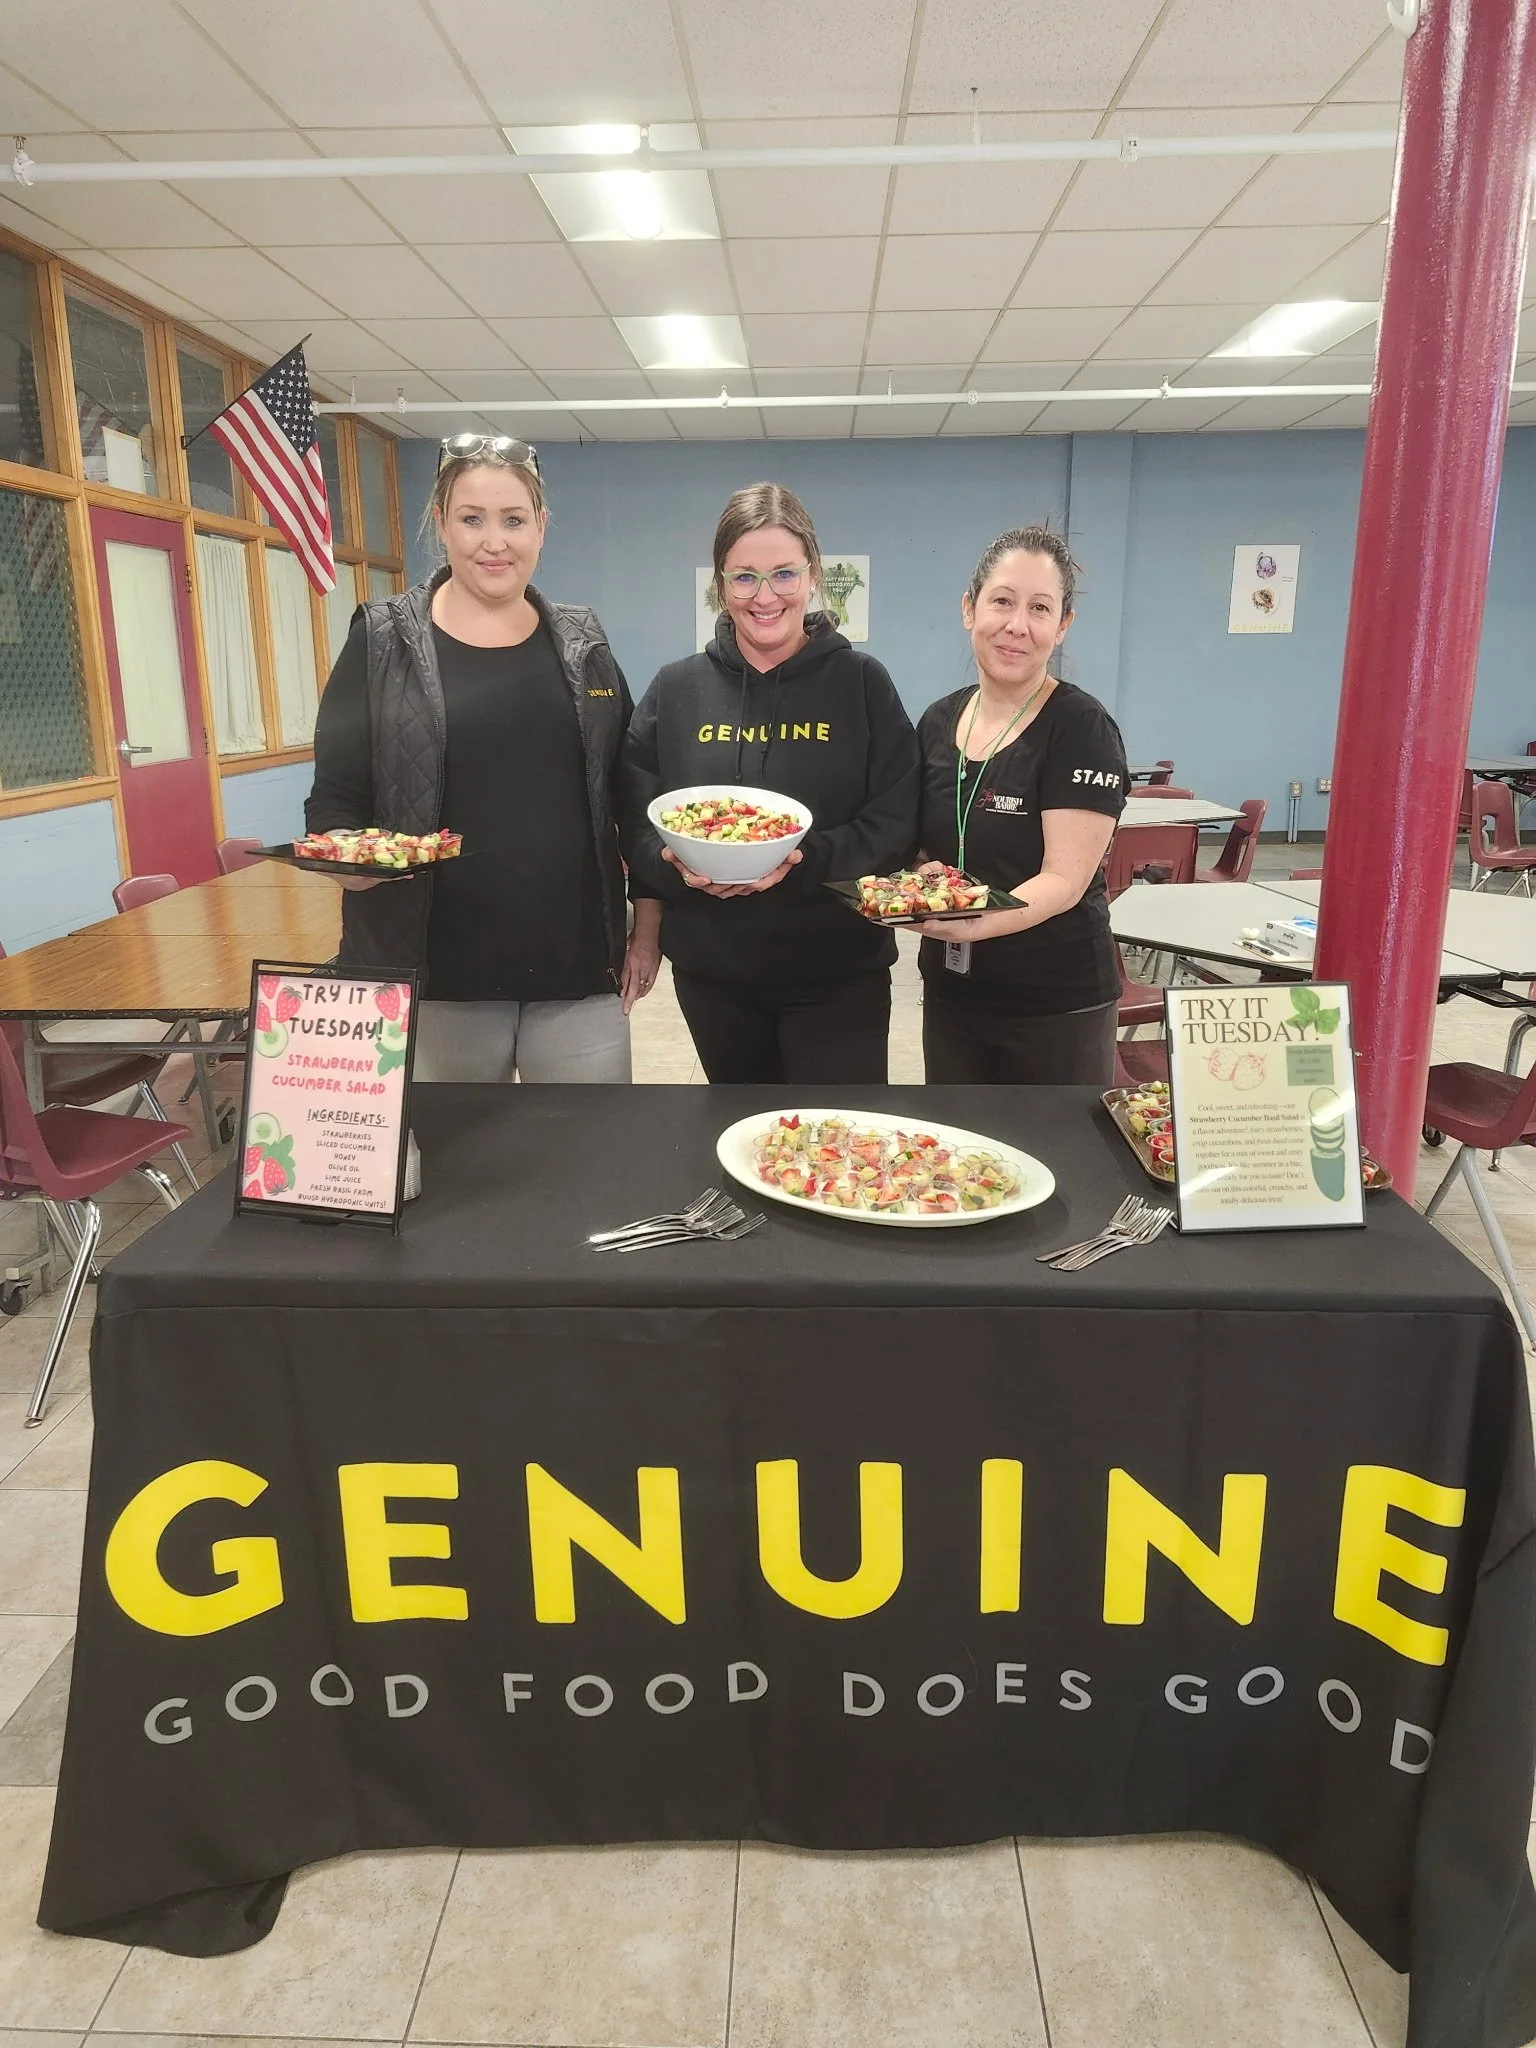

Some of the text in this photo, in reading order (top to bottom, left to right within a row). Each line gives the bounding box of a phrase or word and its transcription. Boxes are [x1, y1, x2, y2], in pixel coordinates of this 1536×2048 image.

[698, 722, 830, 743] GENUINE
[1072, 769, 1120, 789] STAFF
[303, 984, 368, 1005] TRY IT
[1181, 997, 1268, 1020] TRY IT
[289, 1017, 384, 1041] TUESDAY!
[287, 1053, 374, 1072] STRAWBERRY
[272, 1075, 386, 1096] CUCUMBER SALAD
[307, 1108, 386, 1126] INGREDIENTS:
[1189, 1115, 1226, 1123] Strawberry
[322, 1130, 372, 1140] STRAWBERRIES
[316, 1140, 376, 1152] SLICED CUCUMBER
[334, 1153, 356, 1161] HONEY
[328, 1163, 347, 1171] OLIVE
[325, 1174, 341, 1182] LIME
[310, 1184, 373, 1196] FRESH BASIL FROM
[321, 1196, 363, 1206] HYDROPONIC
[365, 1200, 387, 1208] UNITS!
[105, 1459, 1466, 1665] GENUINE
[144, 1661, 1435, 1774] GOOD FOOD DOES GOOD
